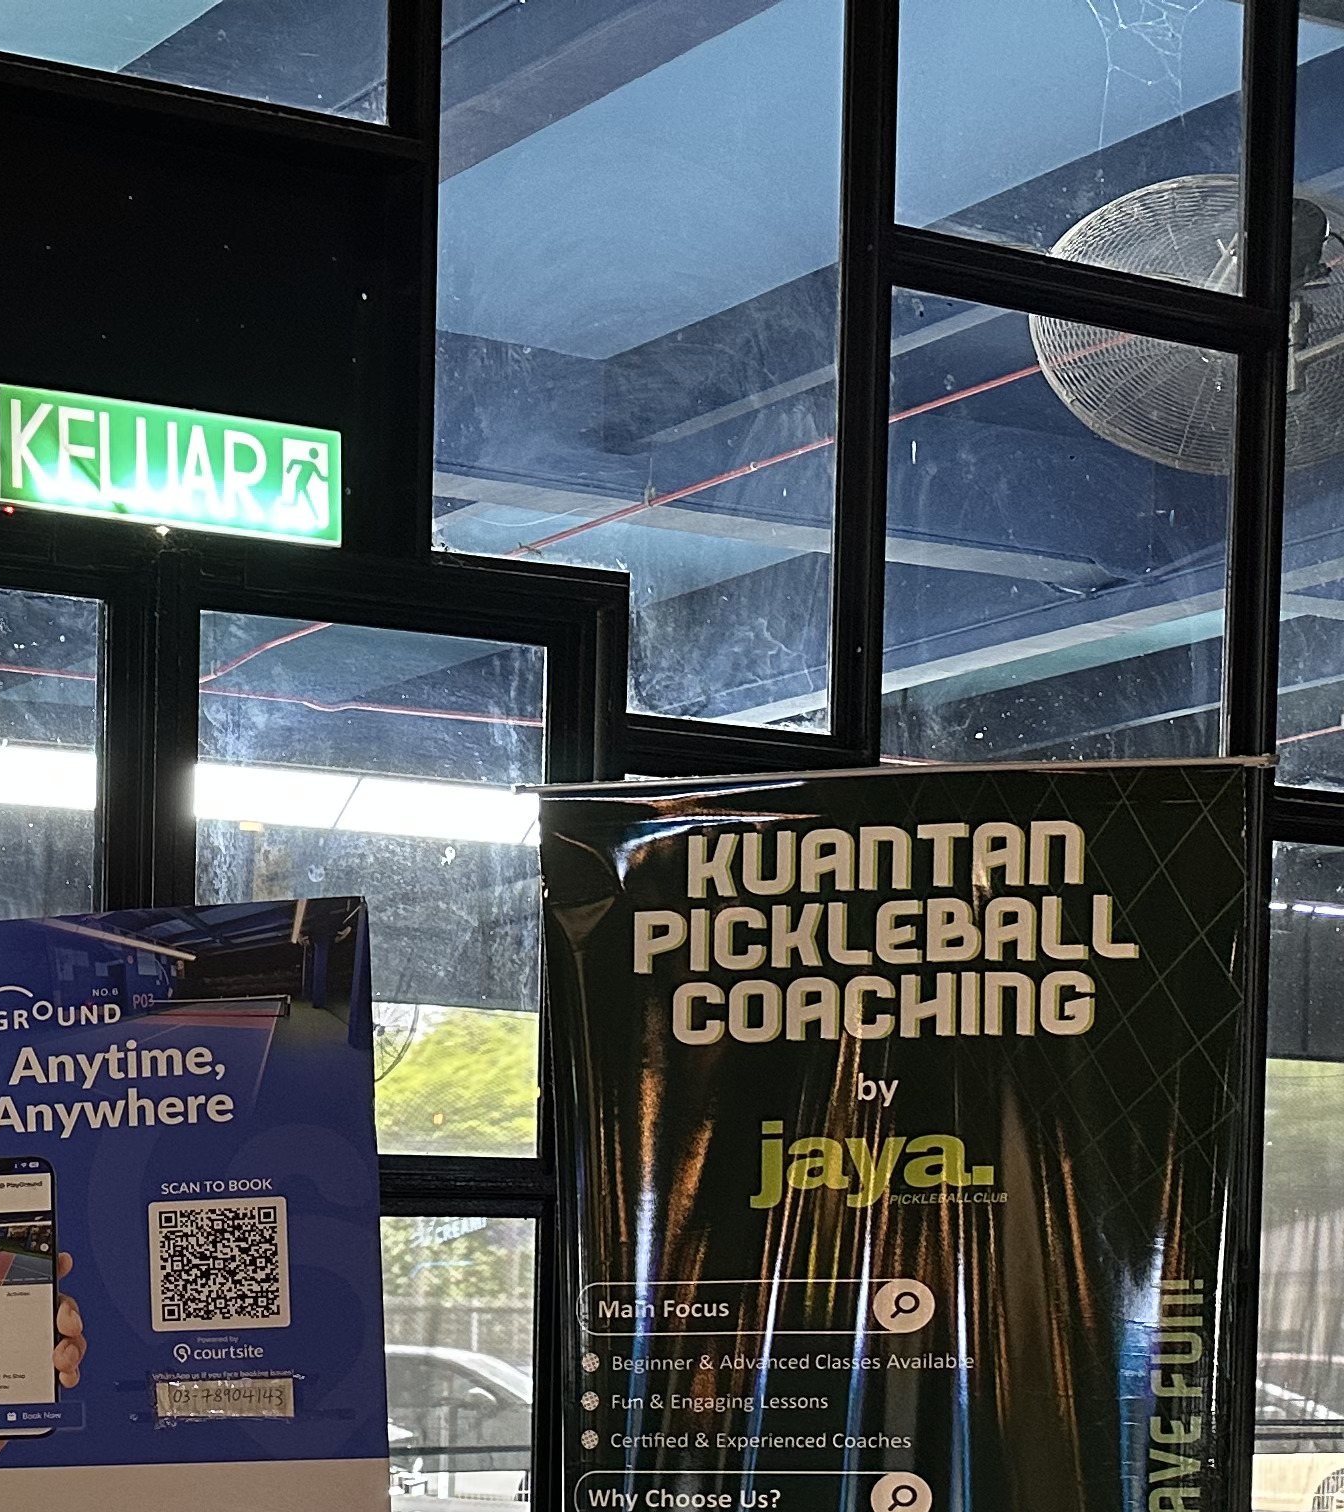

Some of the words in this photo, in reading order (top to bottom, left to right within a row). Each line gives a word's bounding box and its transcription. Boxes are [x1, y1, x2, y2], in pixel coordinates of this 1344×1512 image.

[688, 820, 1086, 898] KUANTAN
[634, 895, 1140, 974] PICKLEBALL
[673, 970, 1096, 1045] COACHING
[9, 1040, 226, 1089] Anytime,
[857, 1072, 899, 1107] by
[750, 1120, 994, 1209] jaya.
[161, 1182, 200, 1195] SCAN
[203, 1181, 224, 1193] TO
[228, 1179, 273, 1192] BOOK
[890, 1193, 971, 1204] PICKLEBALL
[973, 1192, 1008, 1205] CLUB
[194, 1344, 264, 1360] courtsite
[1151, 1279, 1204, 1398] FUN!
[611, 1394, 643, 1409] Fun
[650, 1394, 664, 1409] &
[671, 1394, 754, 1413] Engaging
[761, 1394, 828, 1409] Lessons
[589, 1490, 637, 1511] Why
[645, 1490, 732, 1509] Choose
[740, 1490, 781, 1509] Us?
